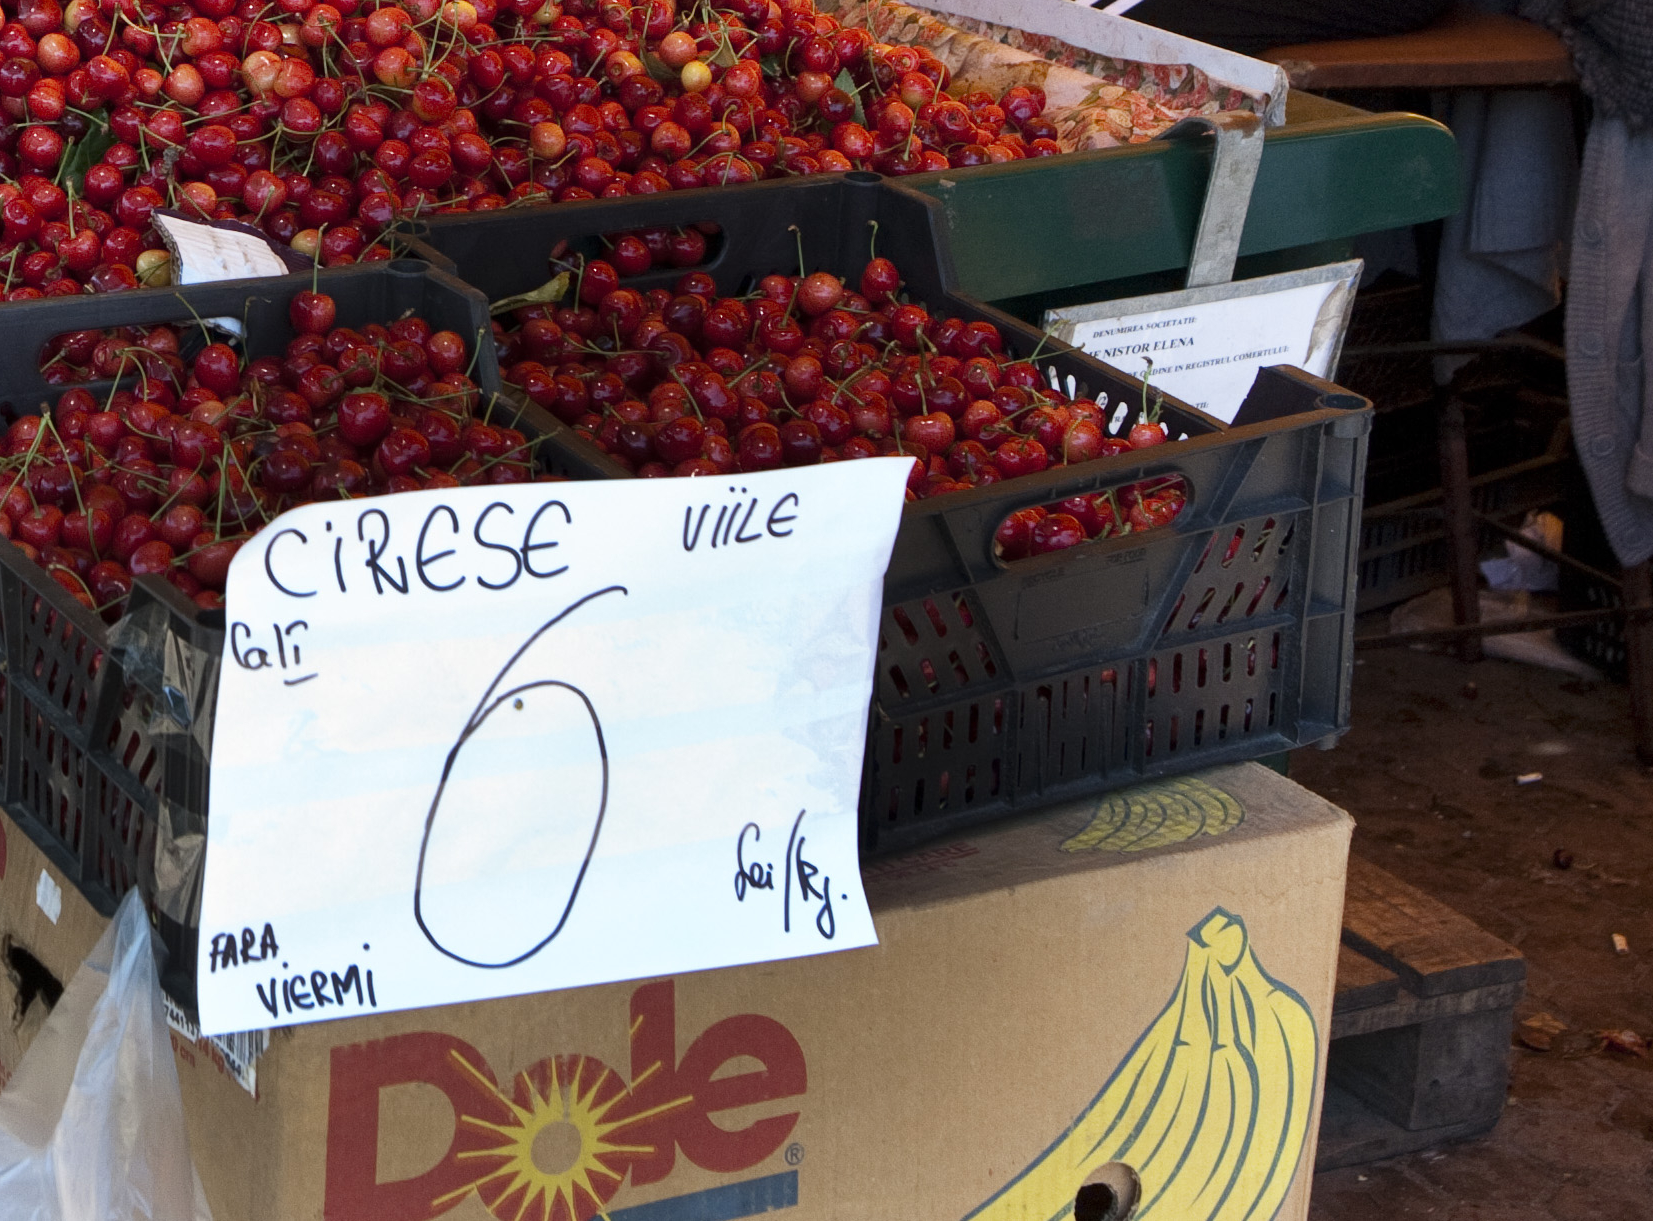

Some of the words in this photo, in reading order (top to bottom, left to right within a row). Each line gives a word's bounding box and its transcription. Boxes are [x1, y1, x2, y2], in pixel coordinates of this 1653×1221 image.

[1093, 324, 1144, 338] DENUMIREA
[1103, 342, 1150, 358] NISTOR
[1153, 336, 1195, 351] ELENA
[1174, 364, 1184, 373] IN
[1185, 356, 1232, 371] REGISTRUL
[264, 500, 571, 598] CIRESE
[414, 586, 628, 969] 6
[209, 922, 279, 973] FARA
[257, 944, 377, 1018] VIERMI
[323, 978, 808, 1221] Dole
